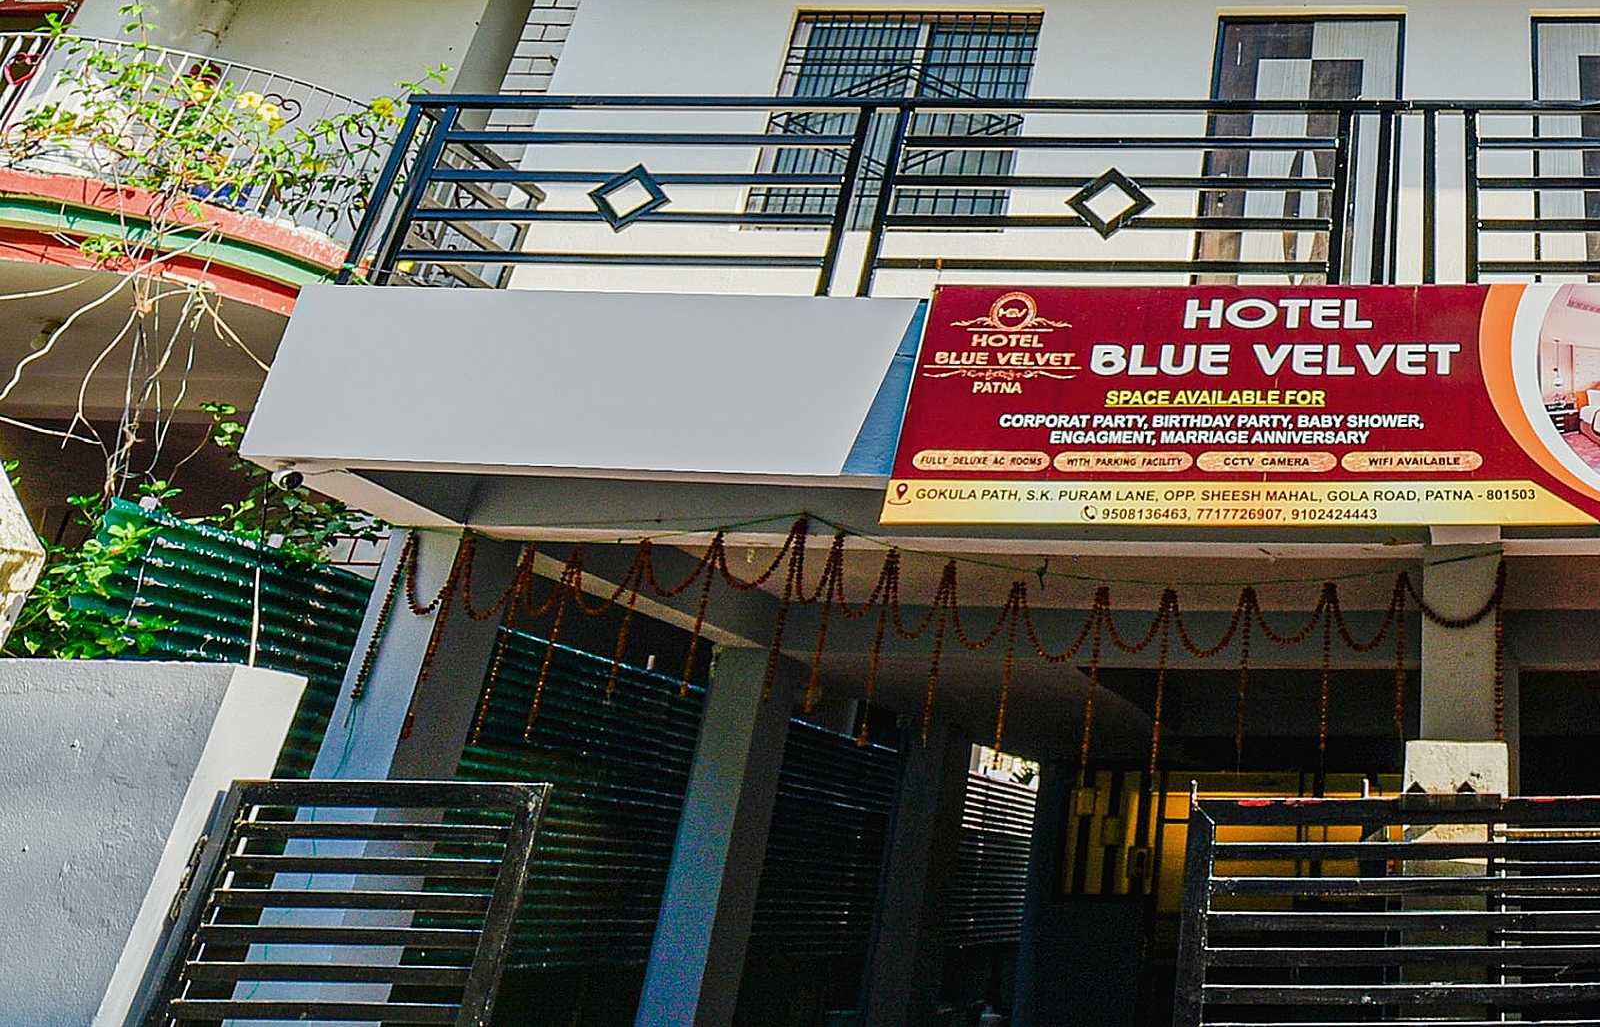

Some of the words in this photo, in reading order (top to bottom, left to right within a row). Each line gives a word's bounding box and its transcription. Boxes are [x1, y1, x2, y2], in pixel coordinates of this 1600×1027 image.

[1183, 298, 1373, 330] HOTEL
[971, 334, 1044, 348] HOTEL
[934, 351, 989, 365] BLUE
[996, 352, 1075, 366] VELVET
[1090, 344, 1232, 376] BLUE
[1252, 344, 1461, 376] VELVET
[972, 381, 1023, 394] PATNA
[1105, 390, 1170, 405] SPACE
[1173, 390, 1279, 405] AVAILABLE
[1284, 390, 1325, 405] FOR
[999, 414, 1090, 428] CORPORAT
[1092, 414, 1149, 430] PARTY,
[1152, 414, 1235, 428] BIRTHDAY
[1237, 414, 1293, 430] PARTY,
[1297, 414, 1343, 428] BABY
[1346, 414, 1425, 429] SHOWER,
[1049, 430, 1157, 446] ENGAGMENT,
[1160, 430, 1249, 444] MARRIAGE
[1250, 430, 1370, 444] ANNIVERSARY
[920, 456, 948, 465] FULLY
[953, 456, 986, 465] DELUXE
[992, 457, 1005, 466] AC
[1010, 457, 1043, 466] ROOMS
[1067, 457, 1090, 466] WITH
[1095, 457, 1137, 466] PARKING
[1141, 457, 1183, 466] FACILITY
[1223, 457, 1254, 466] CCTV
[1261, 457, 1310, 466] CAMERA
[1368, 457, 1393, 466] WIFI
[1396, 457, 1461, 466] AVAILABLE
[915, 488, 977, 500] GOKULA
[981, 489, 1021, 502] PATH,
[1026, 490, 1053, 501] S.K.
[1058, 490, 1112, 501] PURAM
[1115, 490, 1159, 503] LANE,
[1163, 490, 1196, 501] OPP.
[1201, 490, 1261, 501] SHEESH
[1265, 490, 1323, 503] MAHAL,
[1327, 490, 1369, 501] GOLA
[1373, 490, 1421, 502] ROAD,
[1425, 490, 1474, 501] PATNA
[1486, 489, 1536, 500] 801503
[1102, 508, 1191, 521] 9508136463,
[1196, 508, 1286, 521] 7717726907,
[1291, 508, 1378, 520] 9102424443
